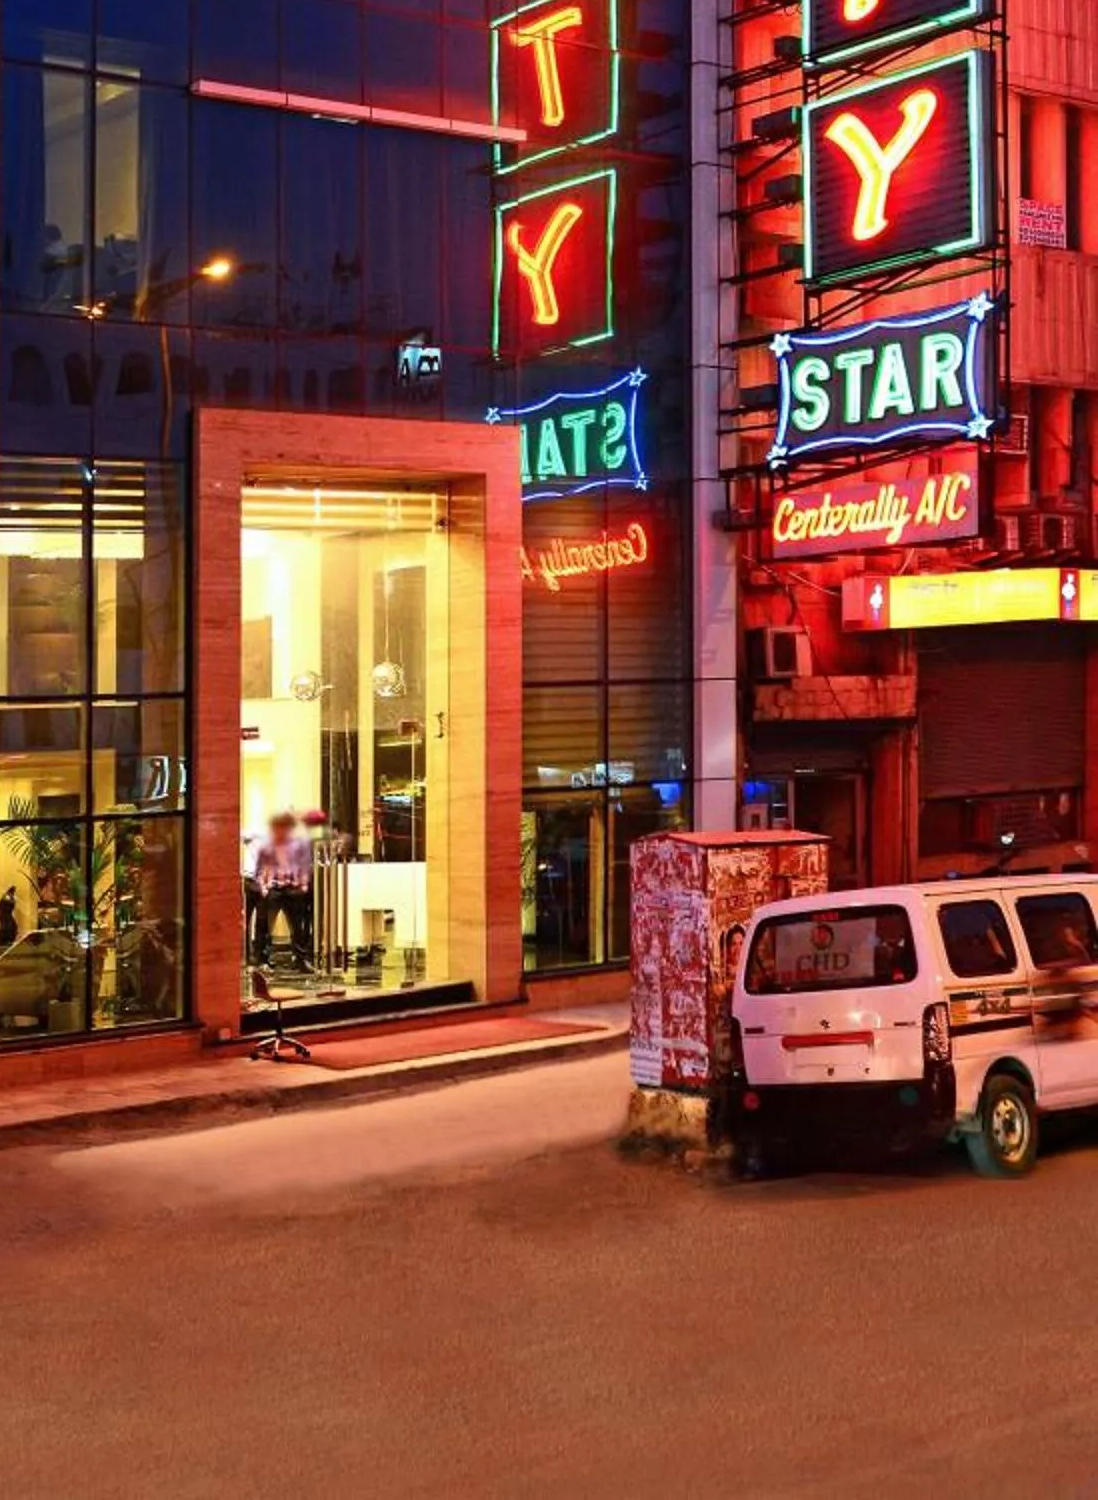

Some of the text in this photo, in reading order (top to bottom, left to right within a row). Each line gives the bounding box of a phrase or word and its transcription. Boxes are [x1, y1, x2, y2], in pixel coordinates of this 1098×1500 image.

[792, 332, 963, 431] STAR
[773, 472, 971, 544] Centerally A/C
[795, 951, 851, 972] CHD
